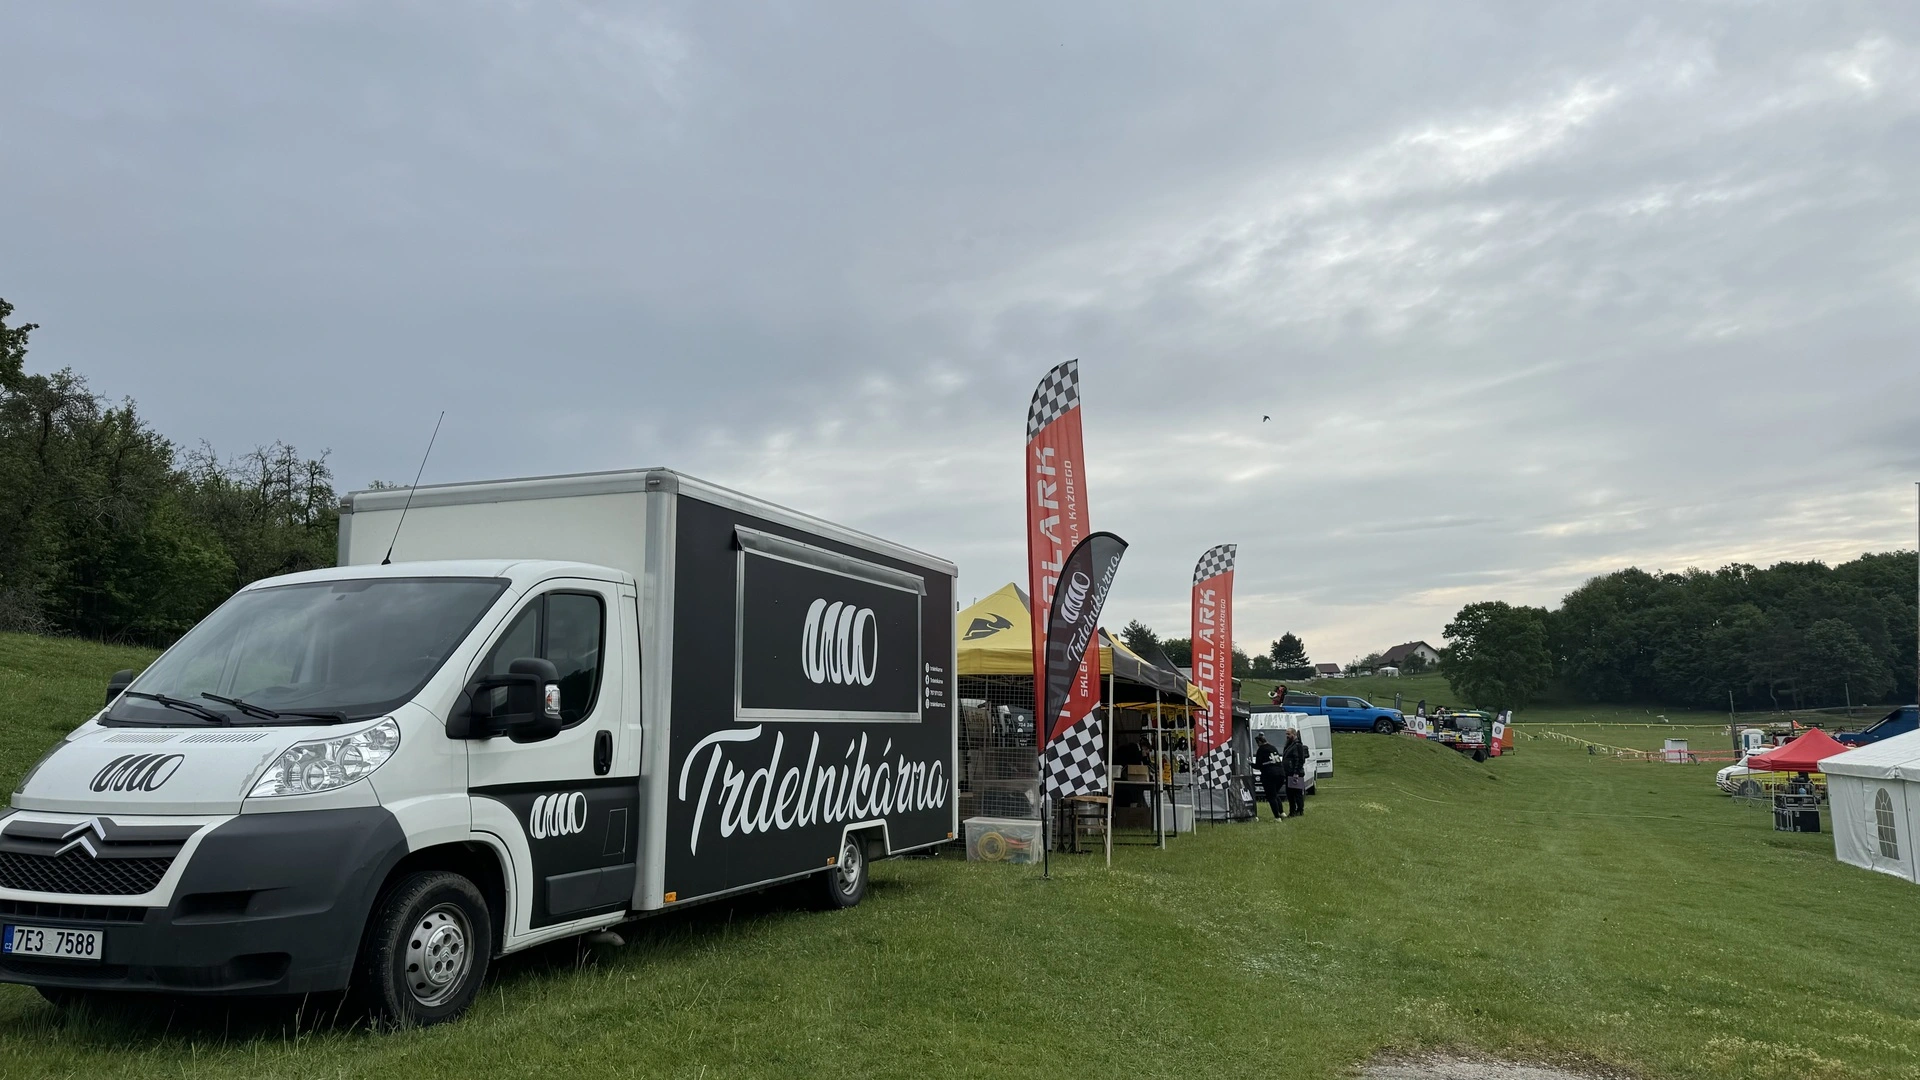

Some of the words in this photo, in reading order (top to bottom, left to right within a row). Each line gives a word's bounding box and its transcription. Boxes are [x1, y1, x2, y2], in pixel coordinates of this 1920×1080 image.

[1064, 460, 1077, 520] KAŻDEGO
[15, 929, 44, 952] 7E3
[55, 931, 95, 956] 7588
